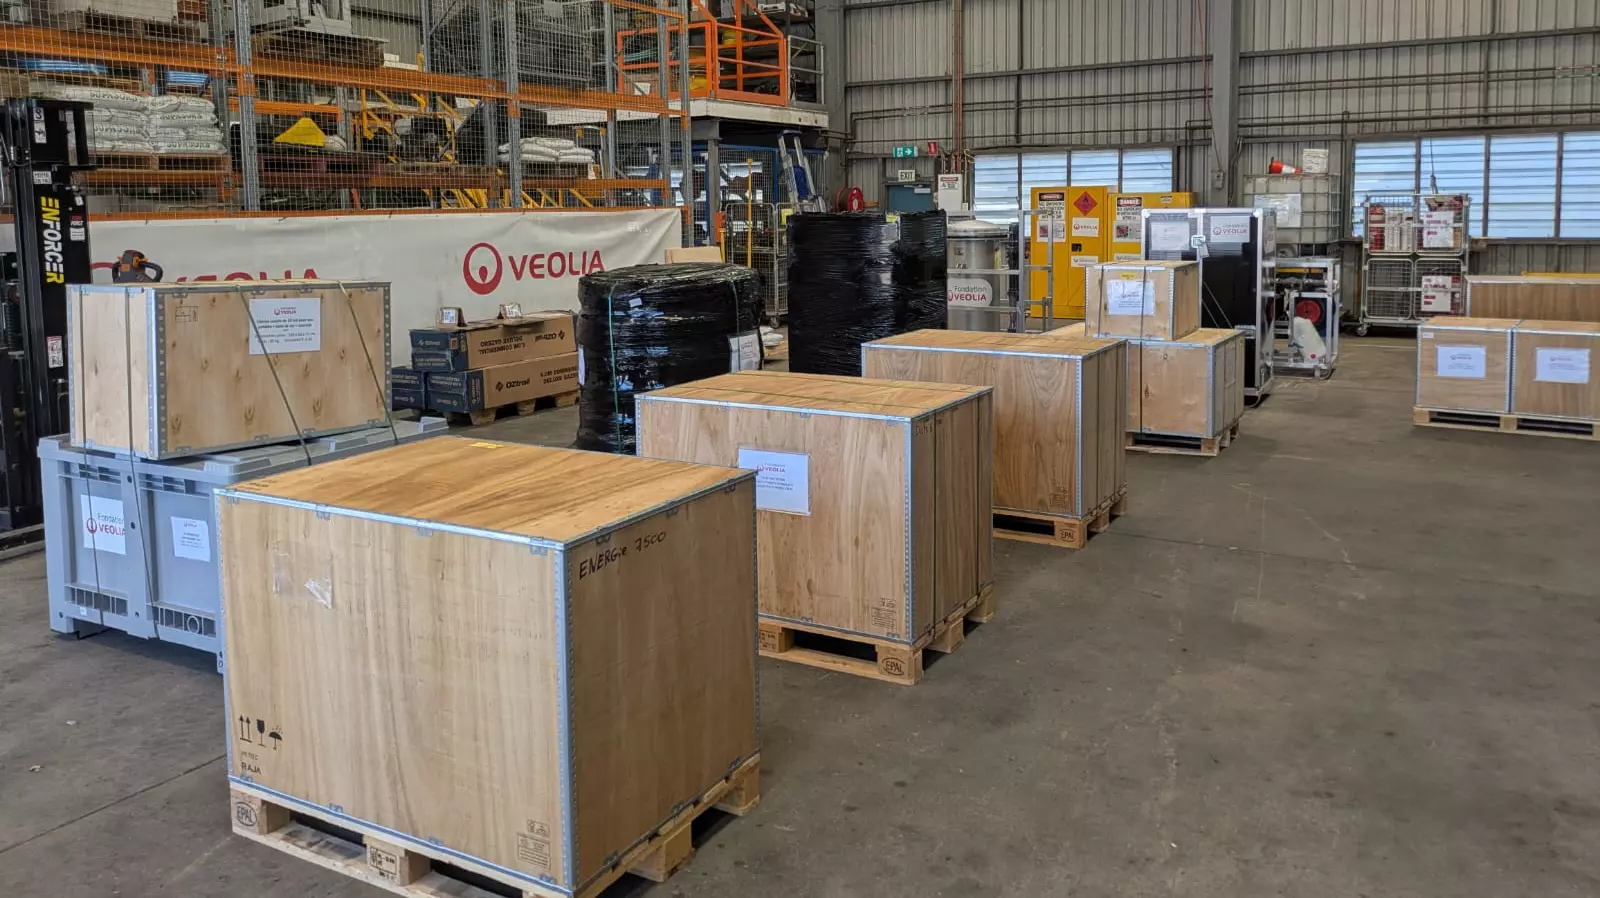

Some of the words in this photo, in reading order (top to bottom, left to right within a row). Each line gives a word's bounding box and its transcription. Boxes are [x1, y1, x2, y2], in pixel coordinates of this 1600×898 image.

[41, 196, 65, 284] ENFORCER
[508, 250, 606, 282] VEOLIA
[954, 293, 987, 302] VEOLIA
[505, 377, 531, 389] OZtrail
[98, 522, 126, 537] VEOLIA
[634, 531, 667, 553] 7500
[885, 660, 903, 674] EPAL
[241, 761, 262, 775] RAJA
[236, 805, 255, 823] EPAL
